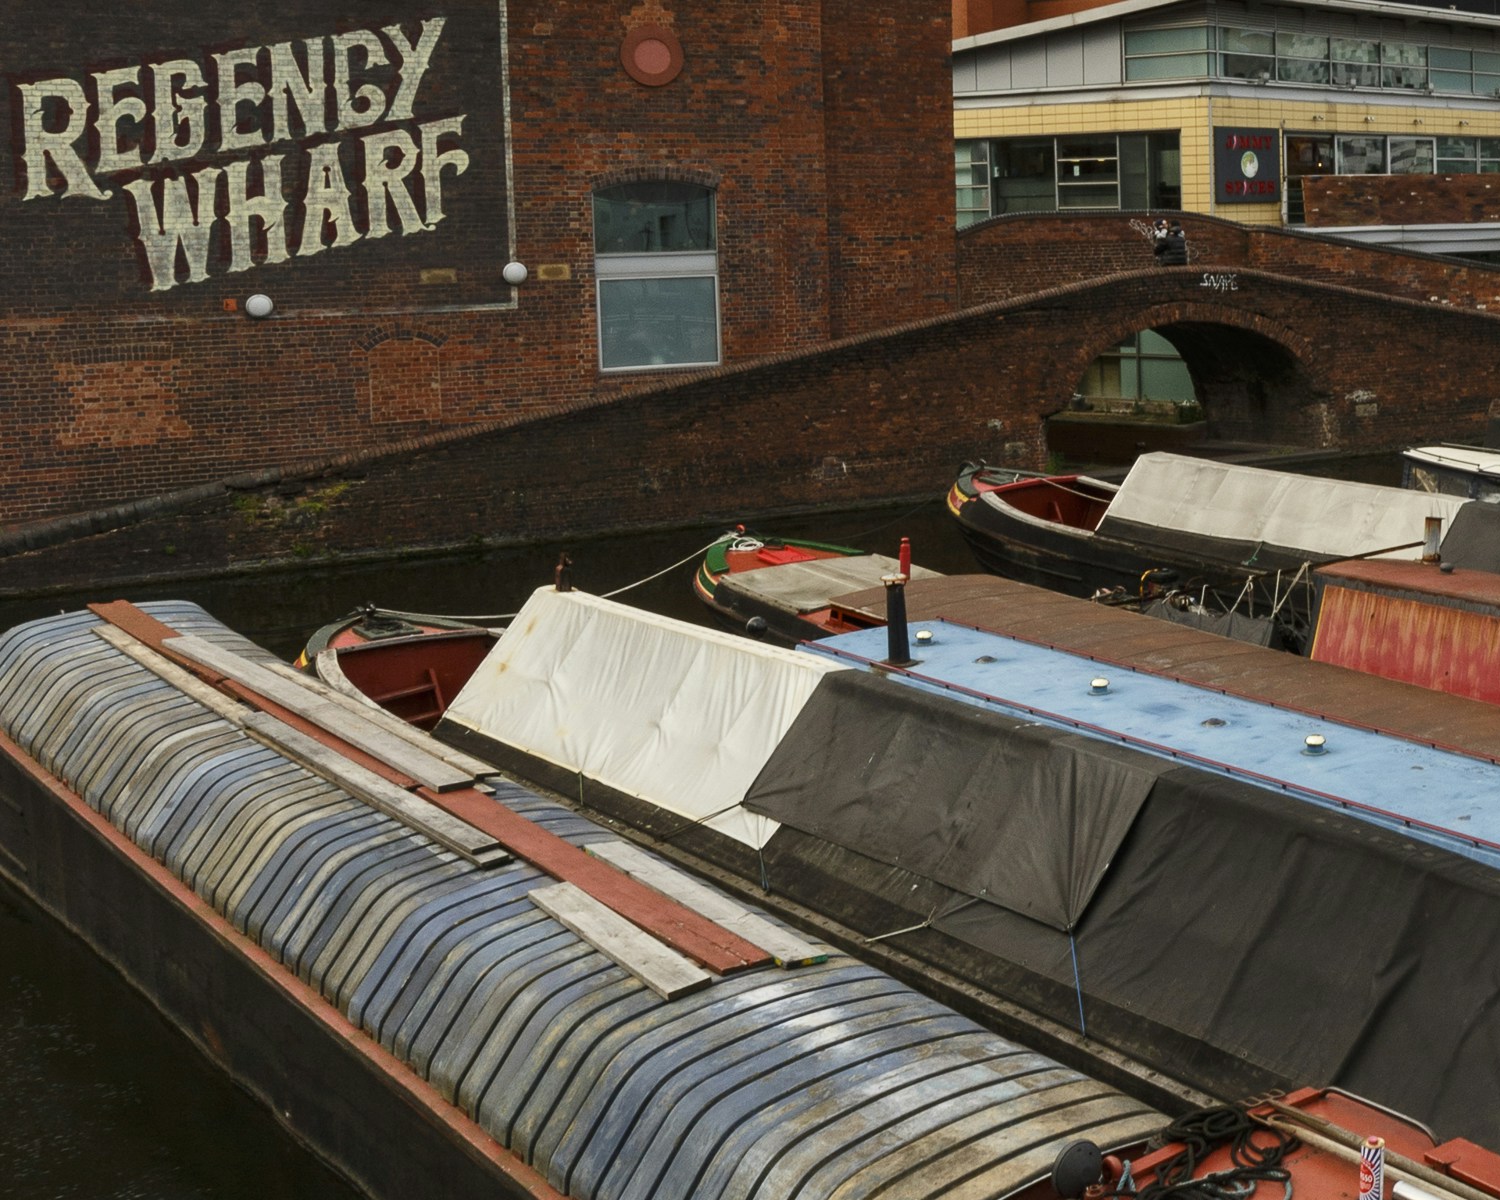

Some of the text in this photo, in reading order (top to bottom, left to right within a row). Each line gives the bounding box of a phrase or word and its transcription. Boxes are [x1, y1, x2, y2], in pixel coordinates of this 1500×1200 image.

[16, 17, 448, 201] REGENCY
[1225, 132, 1273, 151] JIMMY
[122, 114, 470, 292] WHARF
[1224, 180, 1276, 197] SPICES
